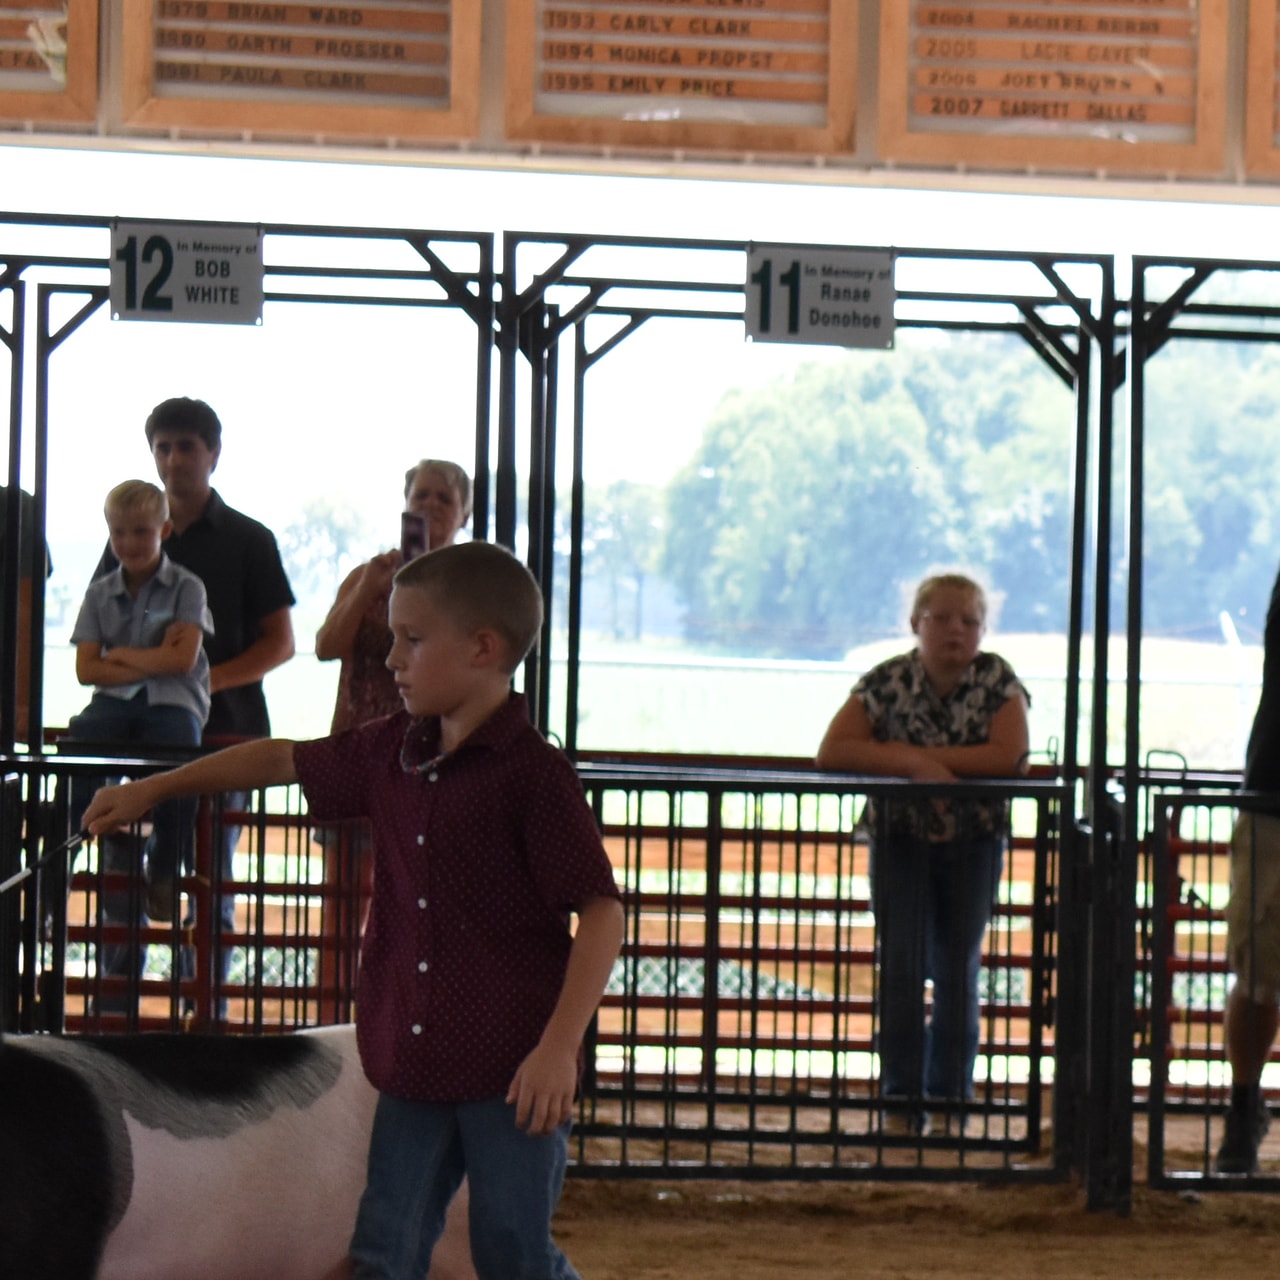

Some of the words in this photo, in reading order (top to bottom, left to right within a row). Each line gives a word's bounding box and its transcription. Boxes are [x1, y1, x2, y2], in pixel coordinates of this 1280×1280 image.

[227, 3, 287, 22] BRIAN
[308, 8, 363, 26] WARD
[547, 11, 596, 29] 1993
[610, 14, 676, 33] CARLY
[689, 18, 752, 36] CLARK
[315, 38, 405, 58] PROSSER
[608, 46, 682, 65] MONICA
[927, 38, 977, 58] 2005
[220, 64, 283, 84] PAULA
[303, 70, 366, 90] CLARK
[608, 76, 667, 93] EMILY
[680, 78, 737, 96] PRICE
[1000, 72, 1049, 88] JOEY
[931, 97, 985, 115] 2007
[1086, 103, 1148, 121] DALLAS
[177, 241, 189, 251] In
[192, 241, 241, 256] Memory
[245, 244, 257, 254] of
[116, 235, 174, 311] 12
[195, 260, 230, 278] BOB
[821, 264, 874, 281] Memory
[186, 285, 239, 304] WHITE
[751, 260, 800, 334] 11
